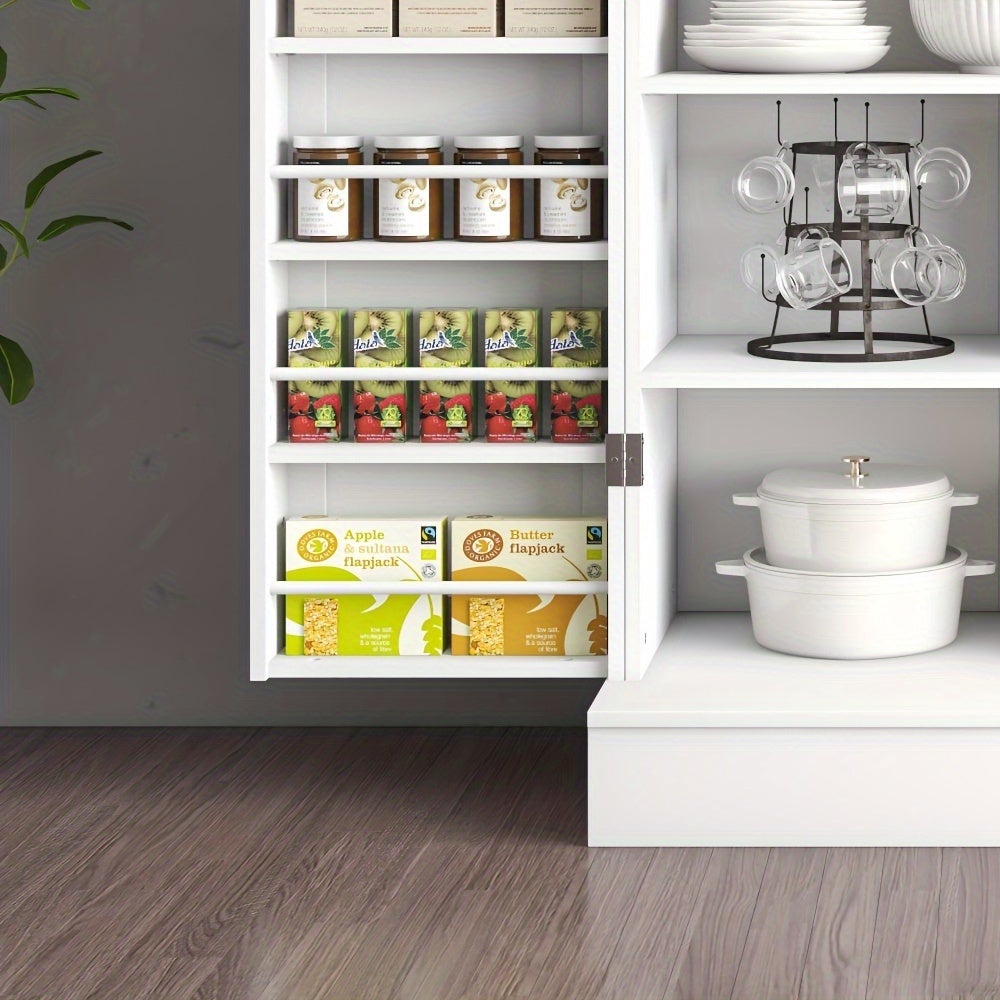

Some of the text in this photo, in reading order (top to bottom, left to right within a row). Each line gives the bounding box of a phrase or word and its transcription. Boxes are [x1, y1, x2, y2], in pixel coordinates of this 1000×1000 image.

[343, 530, 385, 542] Apple
[509, 530, 554, 540] Butter
[344, 543, 409, 554] & sultana
[509, 543, 565, 556] flapjack
[344, 556, 399, 569] flapjack
